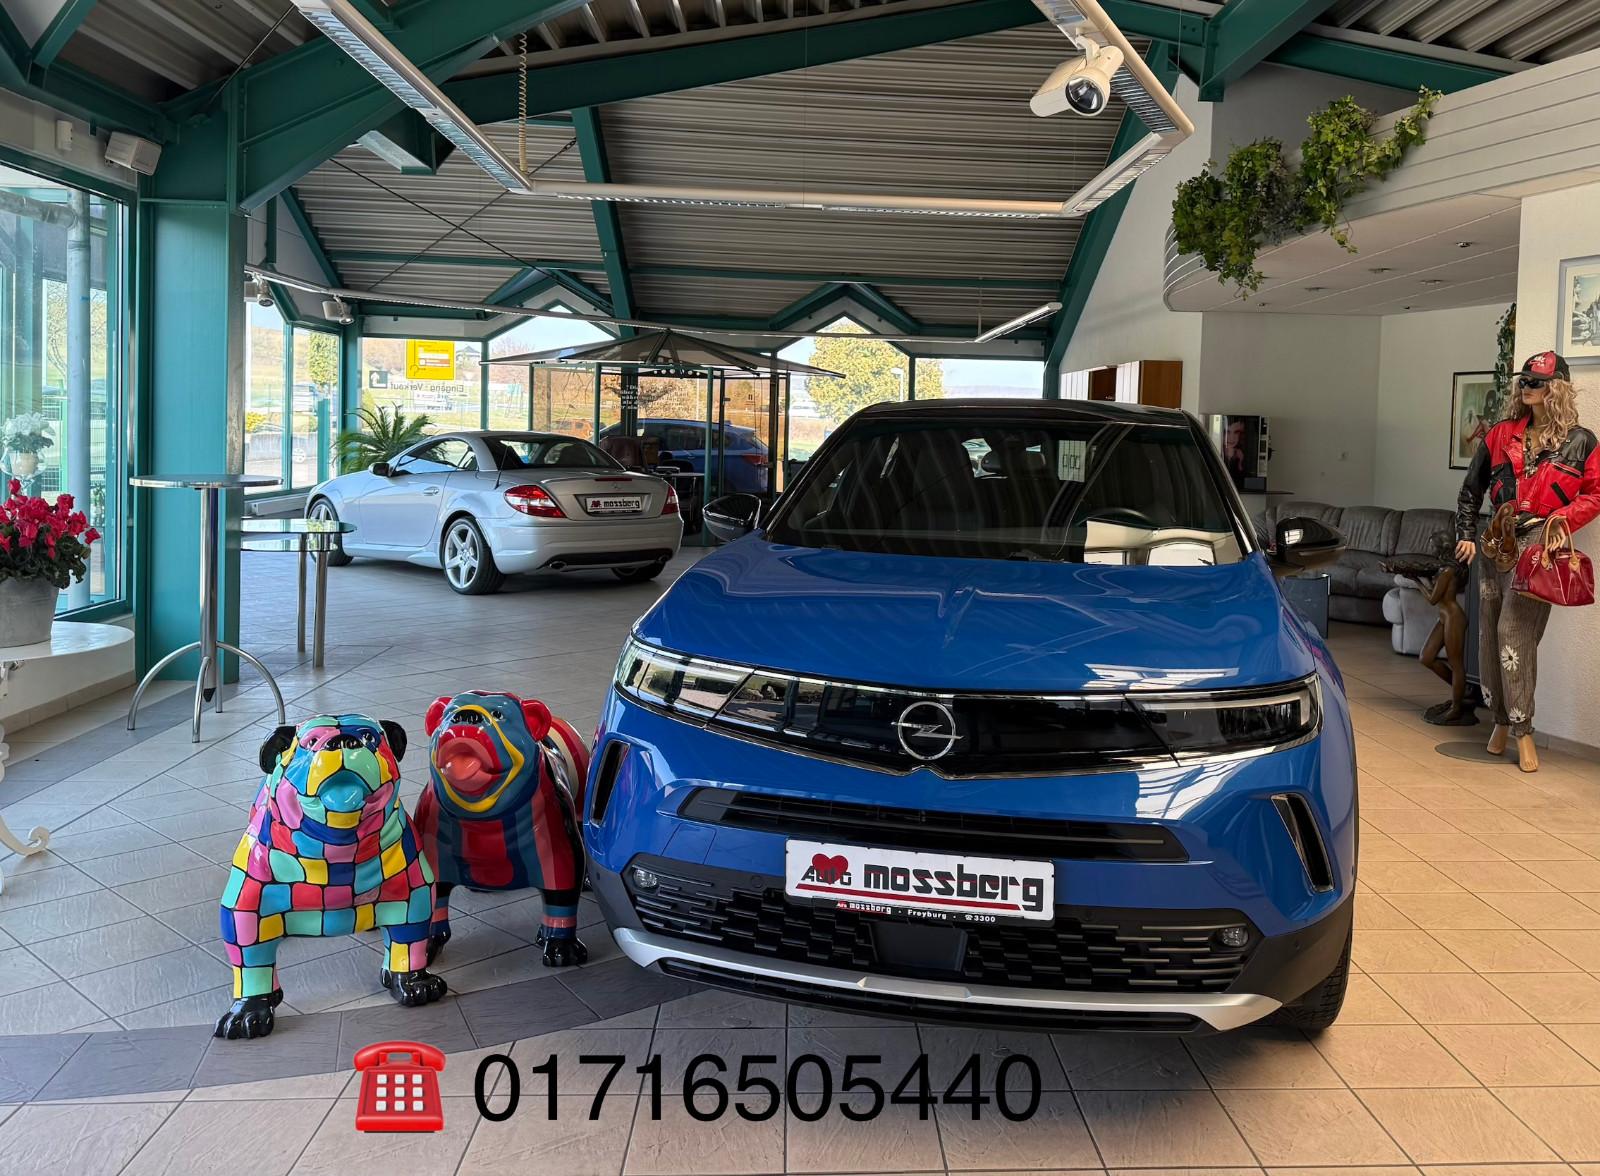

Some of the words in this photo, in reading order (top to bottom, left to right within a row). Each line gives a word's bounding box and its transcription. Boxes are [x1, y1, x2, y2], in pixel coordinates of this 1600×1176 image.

[604, 499, 640, 509] mossberg
[863, 863, 1044, 912] mossberg
[849, 902, 892, 914] mossberg
[907, 909, 947, 919] Freyburg
